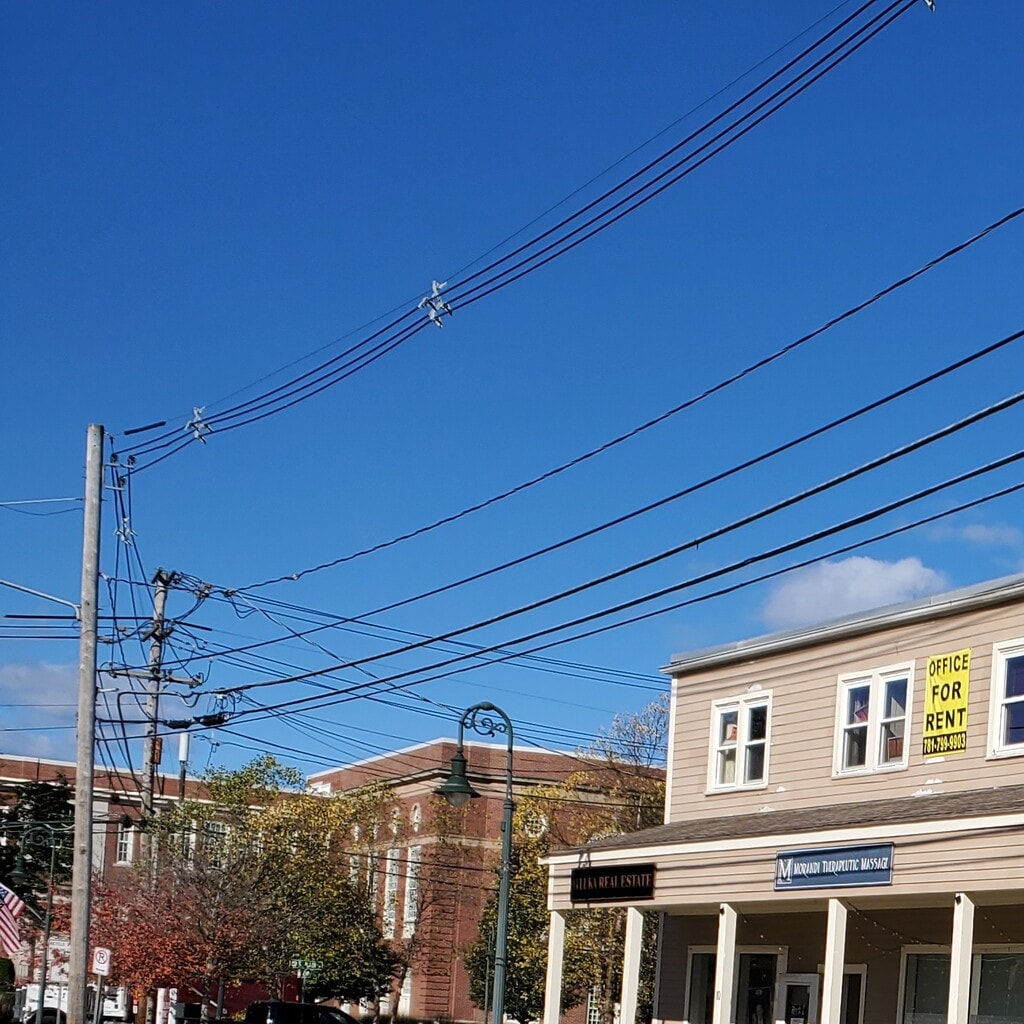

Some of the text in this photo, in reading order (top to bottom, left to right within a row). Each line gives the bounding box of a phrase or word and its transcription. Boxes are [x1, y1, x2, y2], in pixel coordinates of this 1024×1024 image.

[929, 654, 969, 677] OFFICE
[932, 681, 961, 704] FOR
[926, 708, 966, 732] RENT
[822, 859, 859, 876] THERAPEUTIC
[861, 857, 889, 871] MASSAGE
[599, 875, 618, 890] REAL
[621, 873, 652, 889] ESTATE
